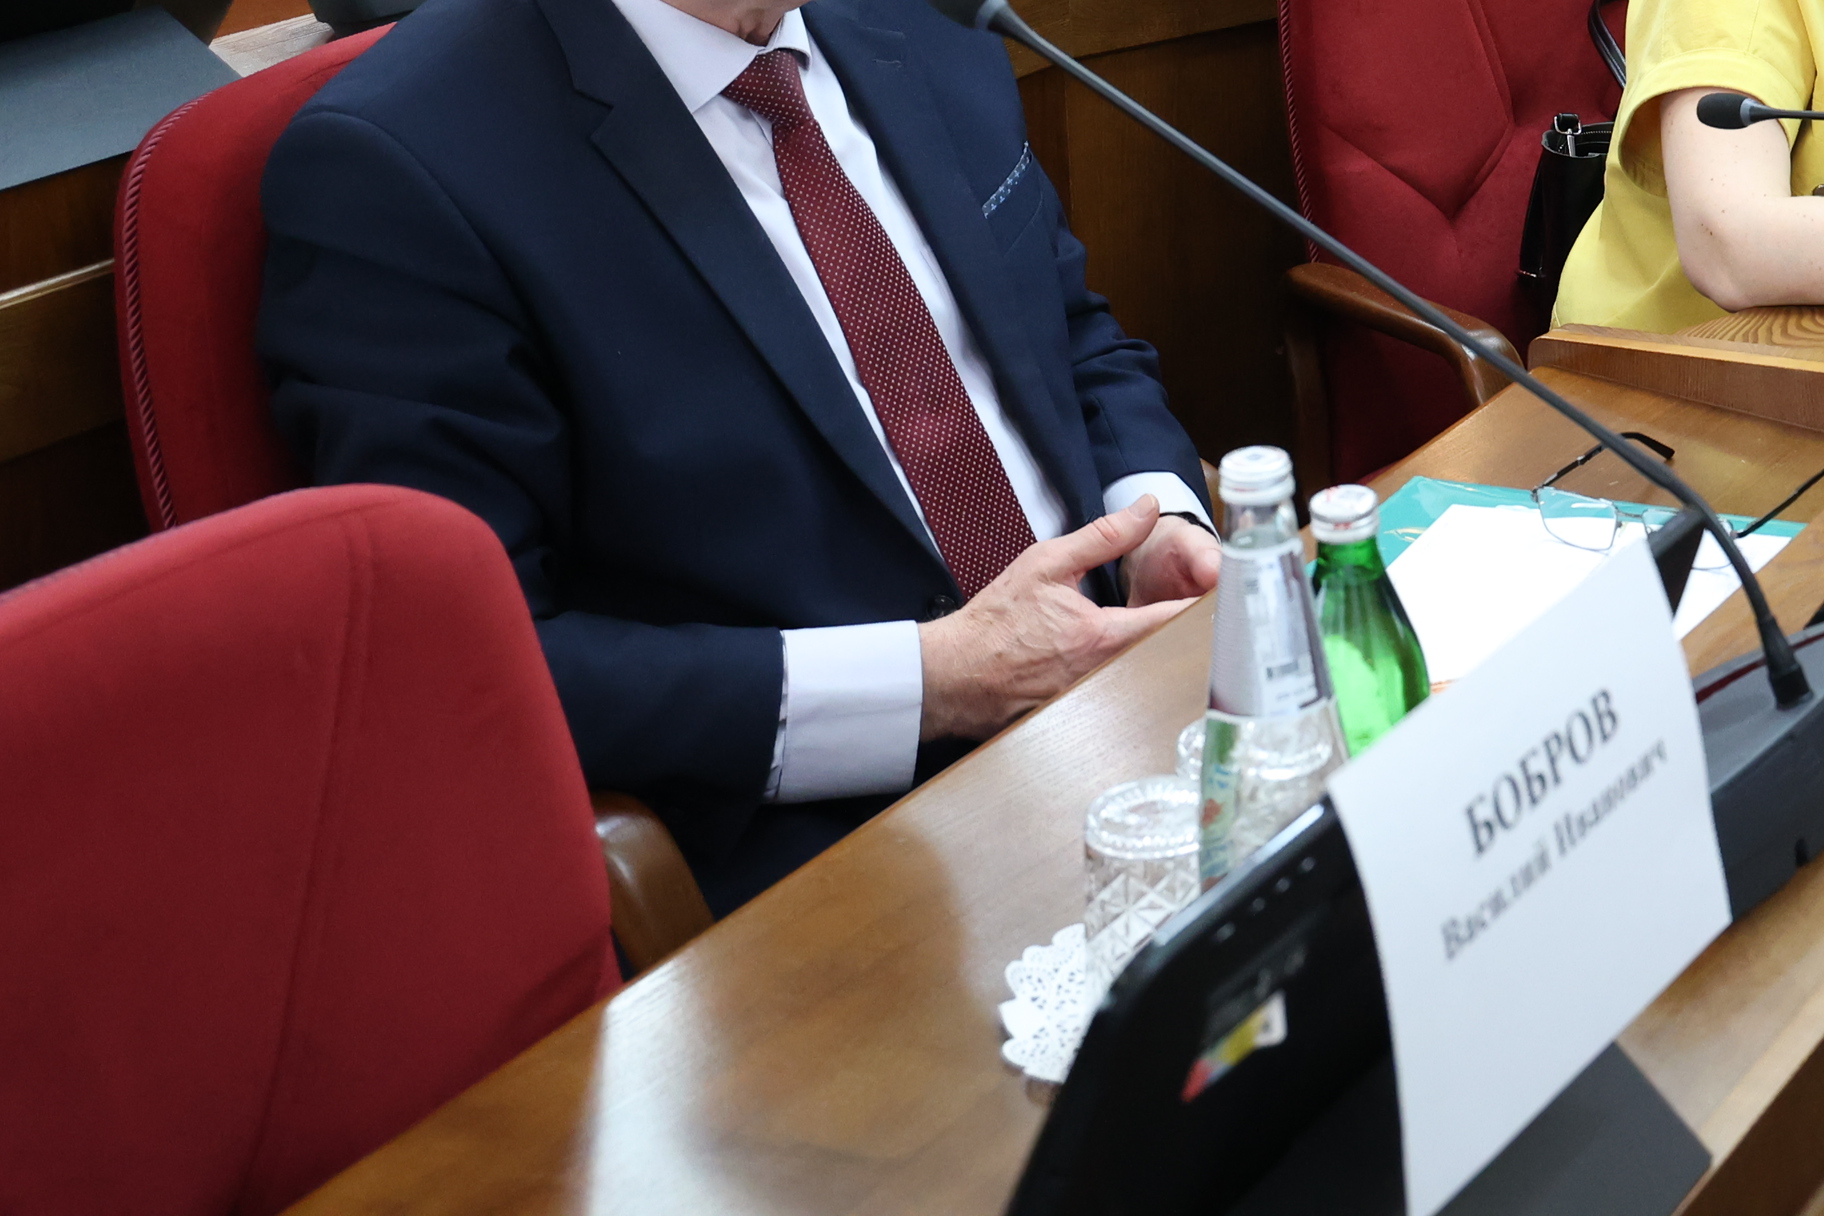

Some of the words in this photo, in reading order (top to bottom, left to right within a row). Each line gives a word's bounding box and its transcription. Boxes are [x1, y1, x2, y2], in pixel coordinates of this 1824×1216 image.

[1439, 840, 1552, 962] Василий
[1552, 738, 1669, 859] Иванович
[1463, 687, 1620, 859] БОБРОВ
